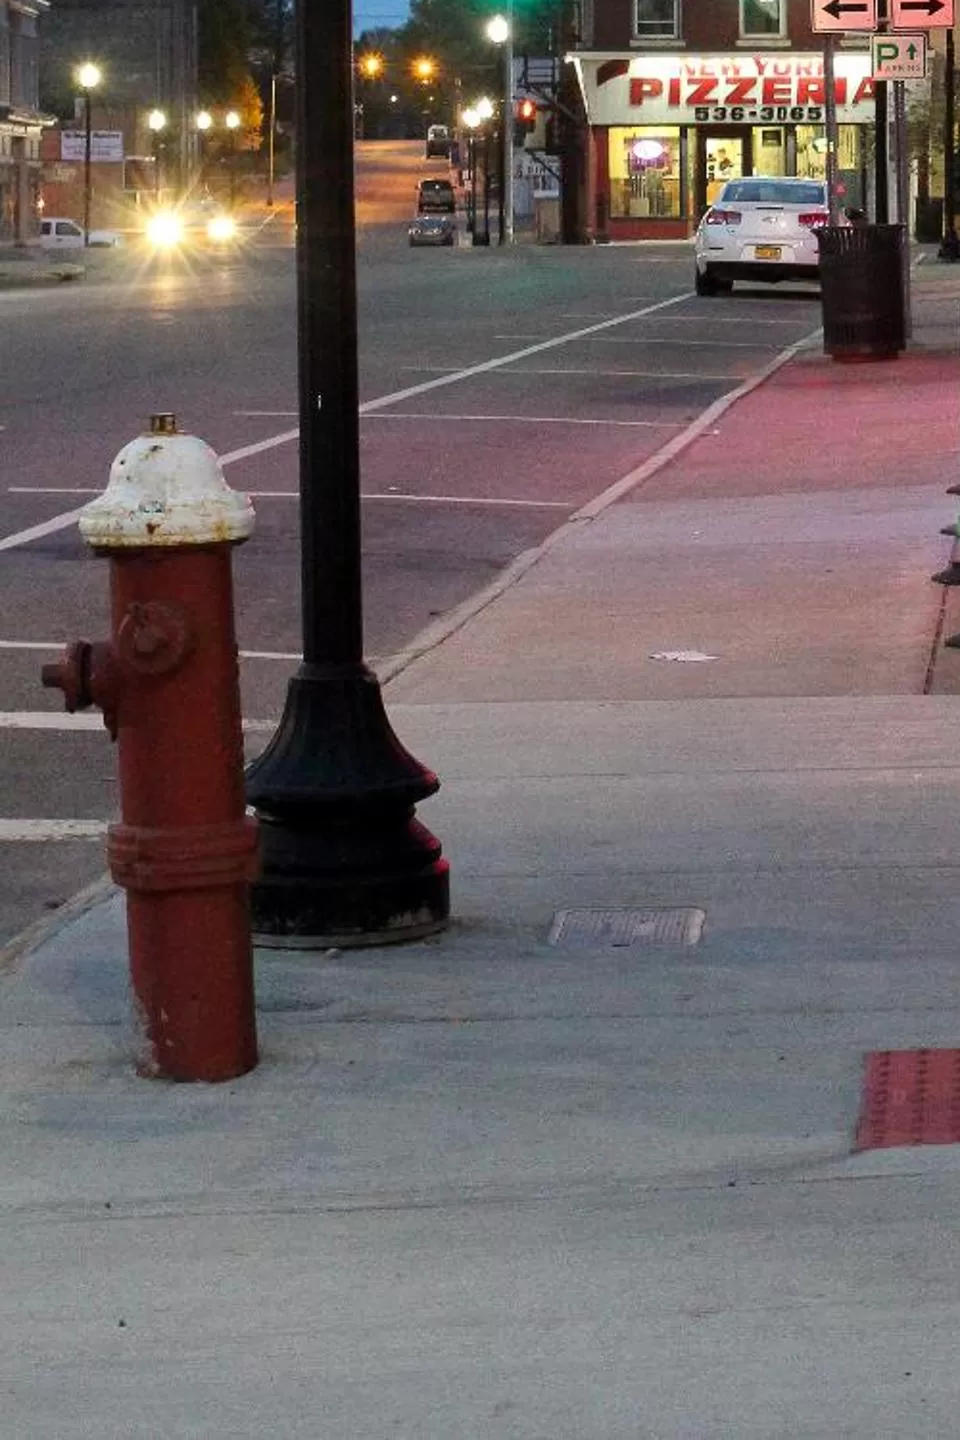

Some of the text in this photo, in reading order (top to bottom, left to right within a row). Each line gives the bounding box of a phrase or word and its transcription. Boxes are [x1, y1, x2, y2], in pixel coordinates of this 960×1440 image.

[682, 59, 741, 76] NEW
[629, 77, 877, 106] PIZZERIA
[695, 107, 822, 121] 536-3065
